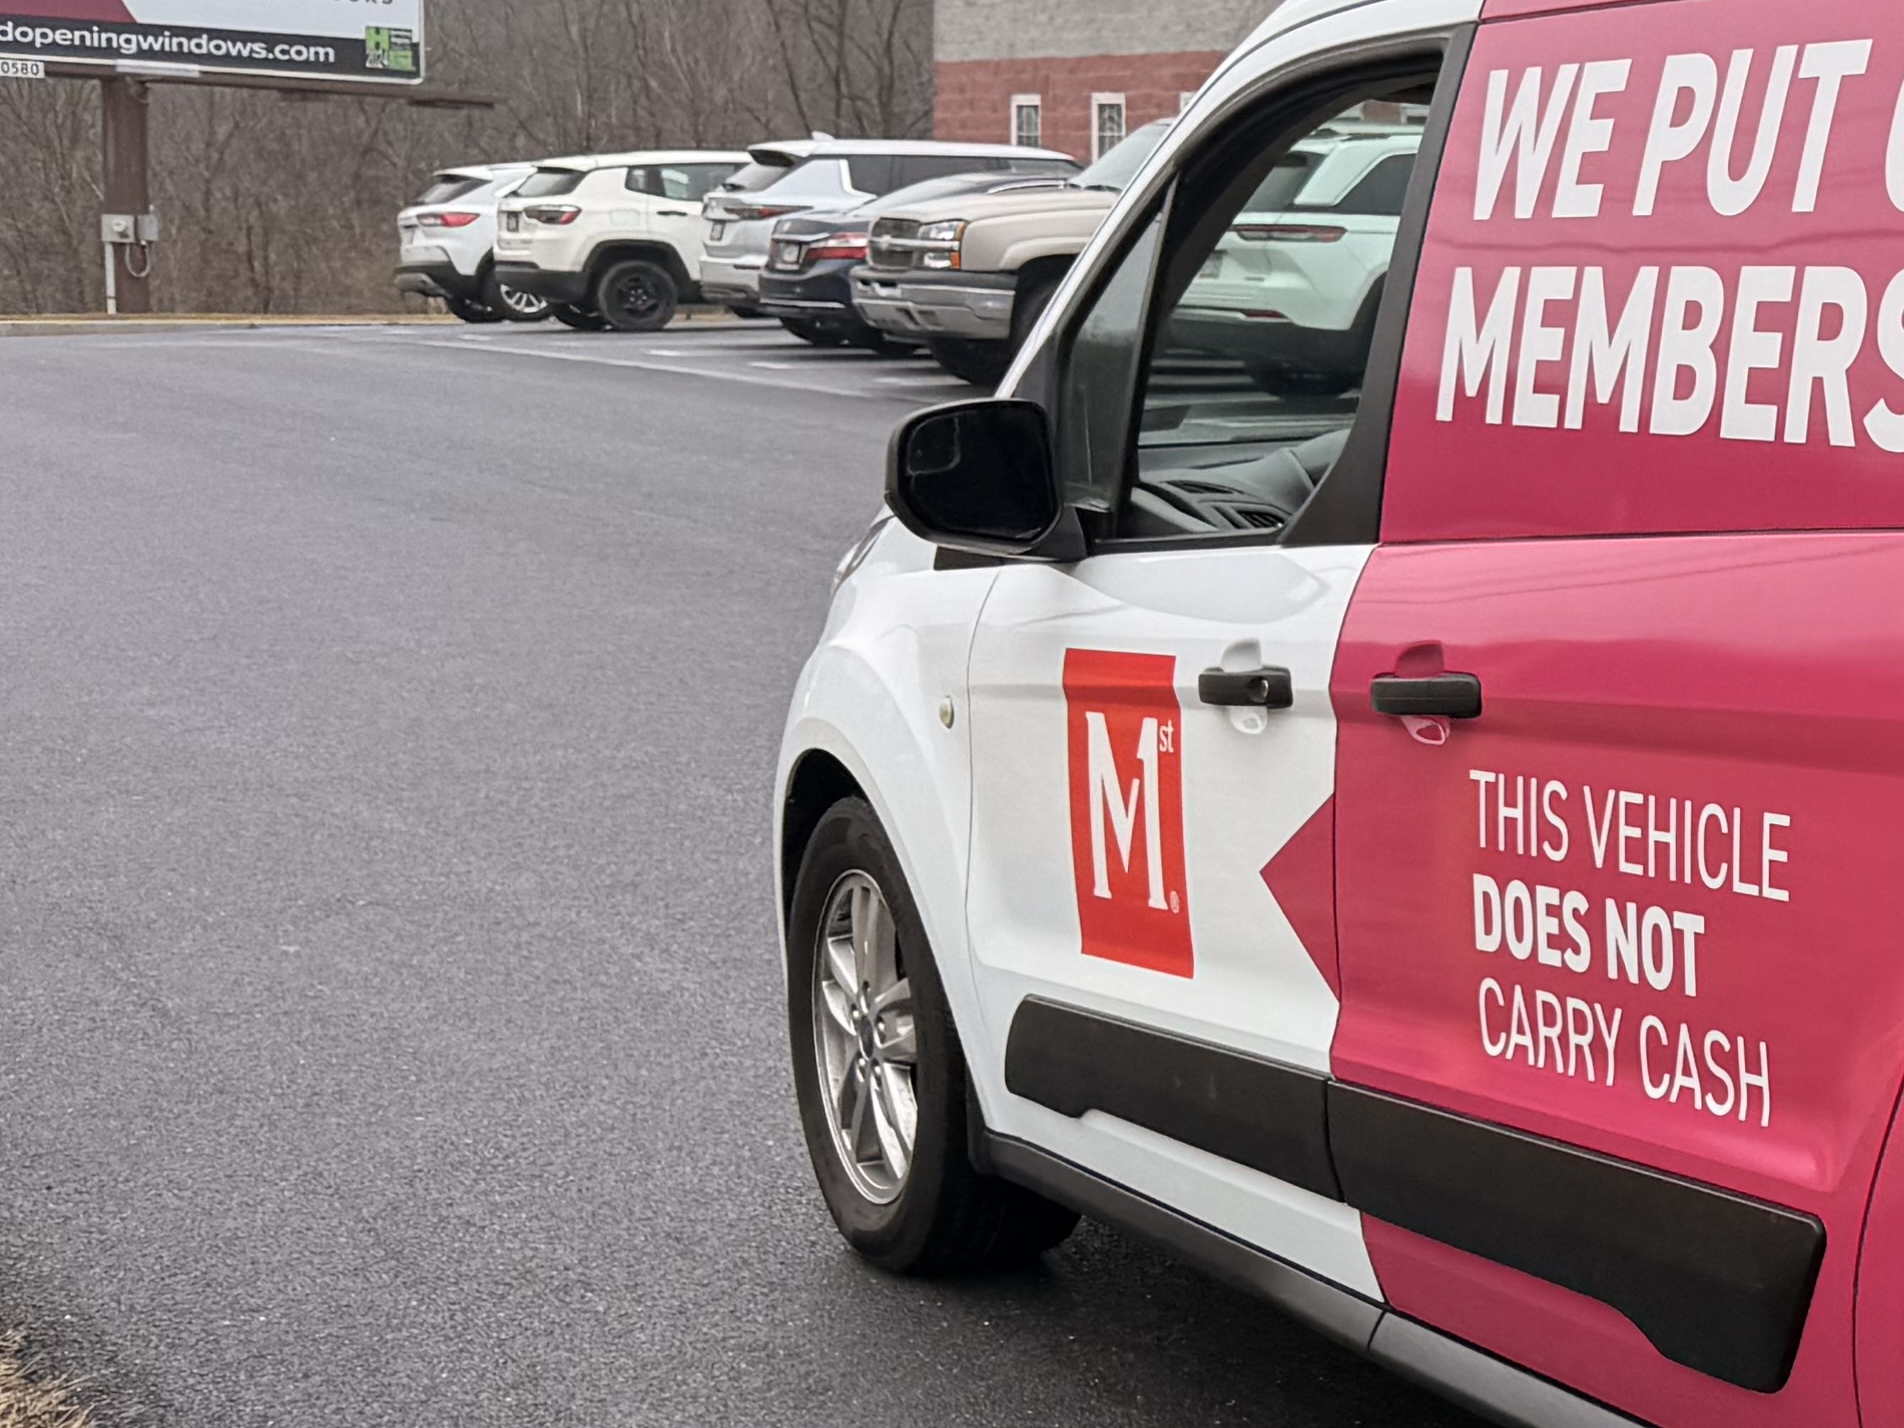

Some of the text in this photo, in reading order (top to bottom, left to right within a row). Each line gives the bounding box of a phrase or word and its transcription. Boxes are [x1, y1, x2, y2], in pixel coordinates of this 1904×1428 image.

[0, 21, 335, 63] dopeningwindows.com
[1, 61, 40, 76] 0580
[1474, 59, 1632, 220] WE
[1632, 38, 1873, 218] PUT
[1469, 769, 1790, 902] THIS VEHICLE
[1473, 873, 1704, 997] DOES NOT
[1479, 977, 1771, 1127] CARRY CASH
